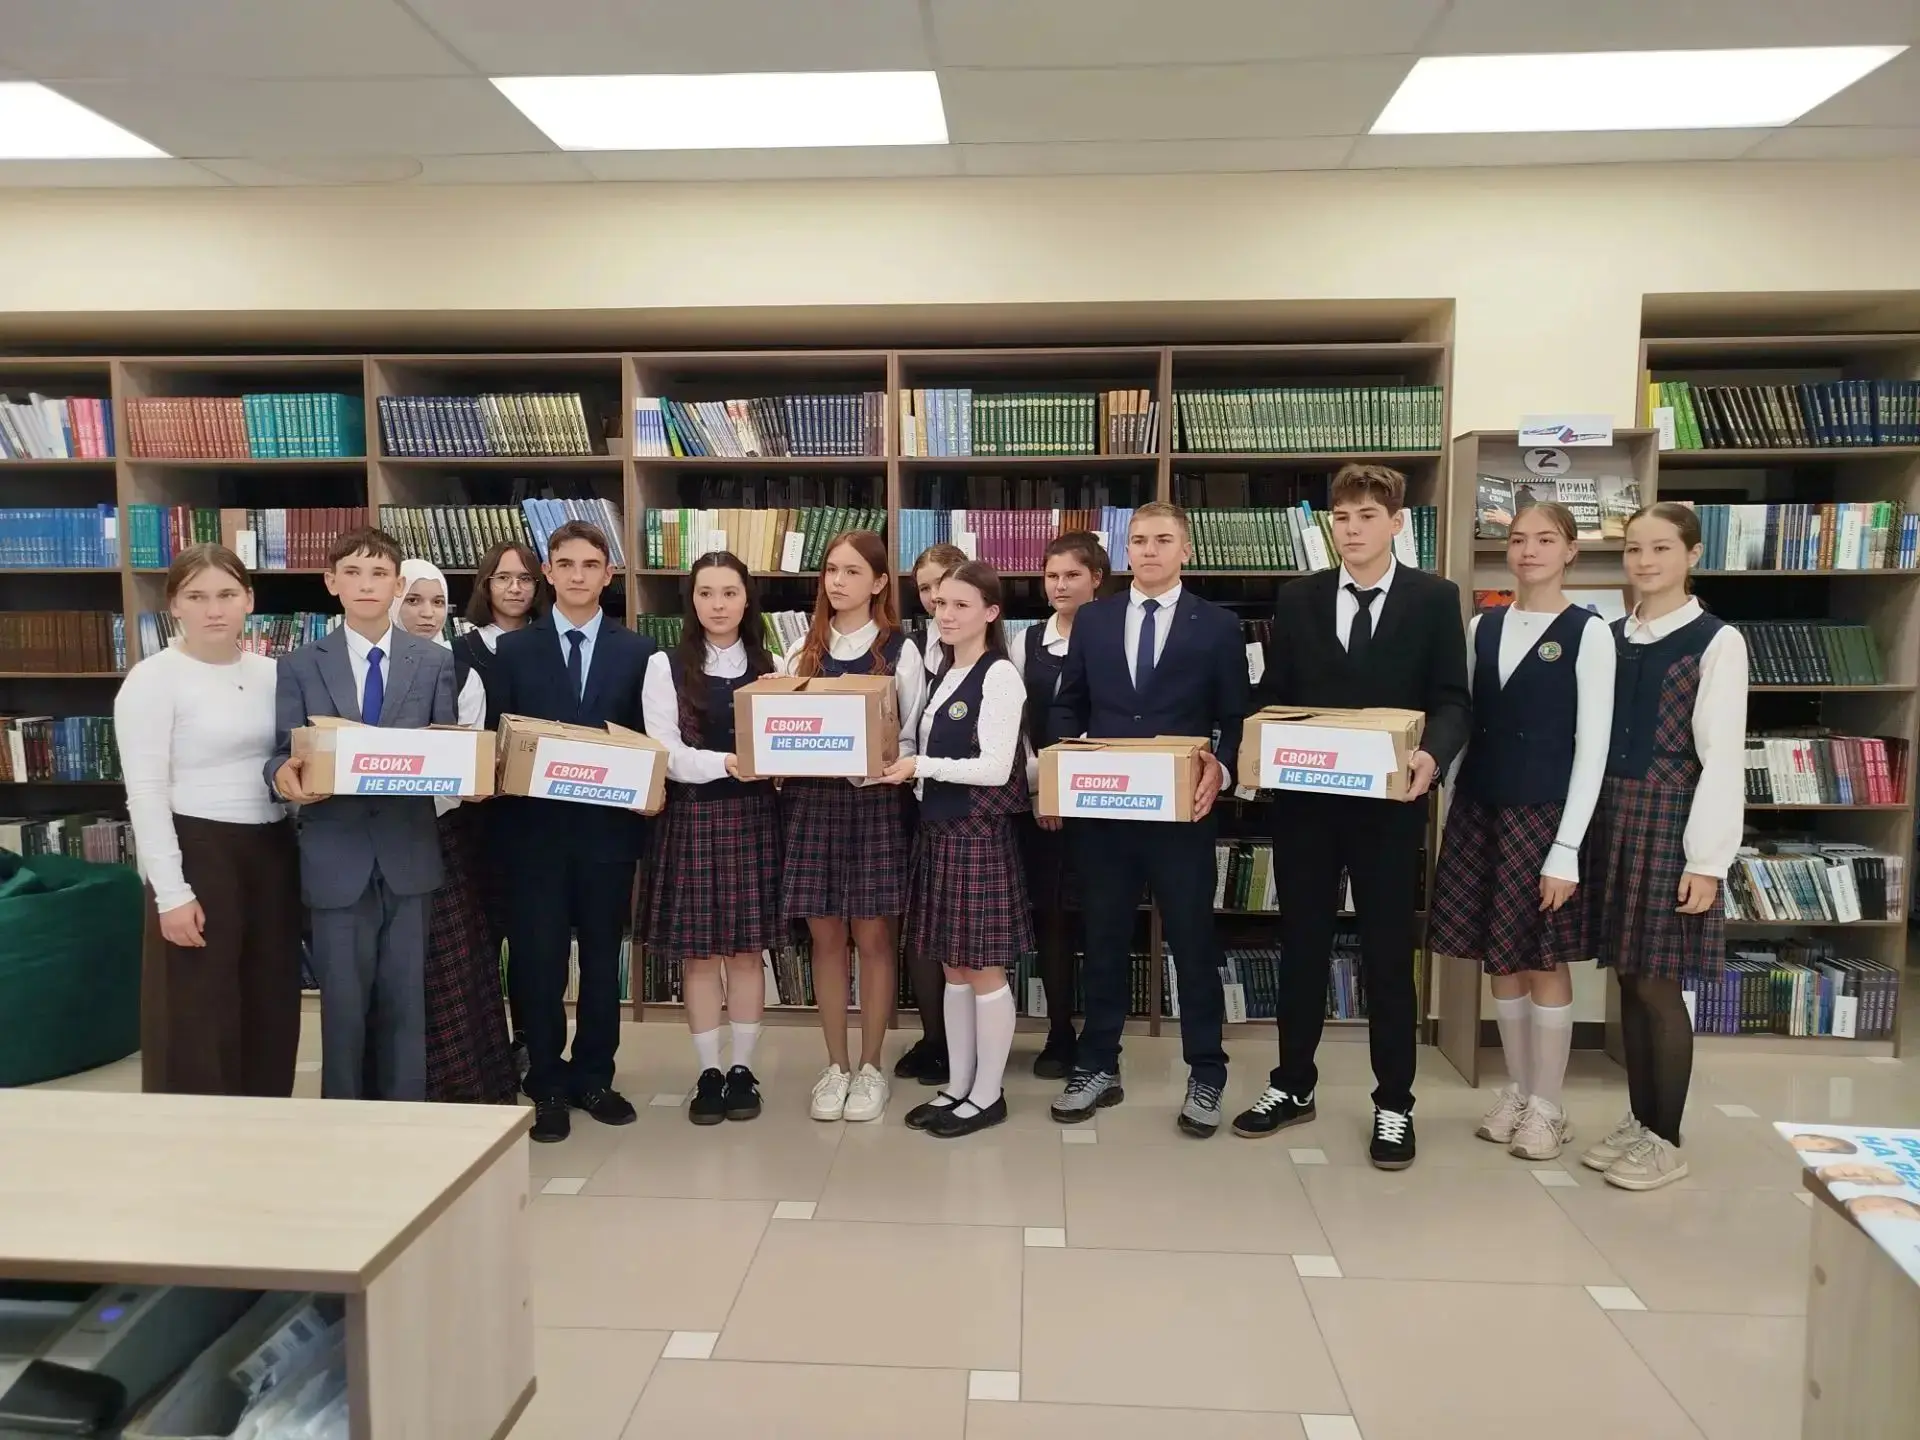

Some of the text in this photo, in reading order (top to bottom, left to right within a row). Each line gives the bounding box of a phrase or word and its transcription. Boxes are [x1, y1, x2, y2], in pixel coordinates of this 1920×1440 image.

[1535, 449, 1559, 468] Z
[1558, 482, 1598, 494] ИРИНА
[771, 719, 814, 732] СВОИХ
[777, 737, 850, 749] НЕ БРОСАЕМ
[358, 756, 413, 772] СВОИХ
[1279, 751, 1328, 766] СВОИХ
[551, 764, 598, 781] СВОИХ
[1285, 770, 1367, 788] НЕ БРОСАЕМ
[364, 779, 455, 792] НЕ БРОСАЕМ
[1075, 776, 1120, 789] СВОИХ
[554, 783, 631, 801] НЕ БРОСАЕМ
[1082, 795, 1157, 808] НЕ БРОСАЕМ
[1855, 1136, 1898, 1156] НА
[1890, 1137, 1920, 1164] РА
